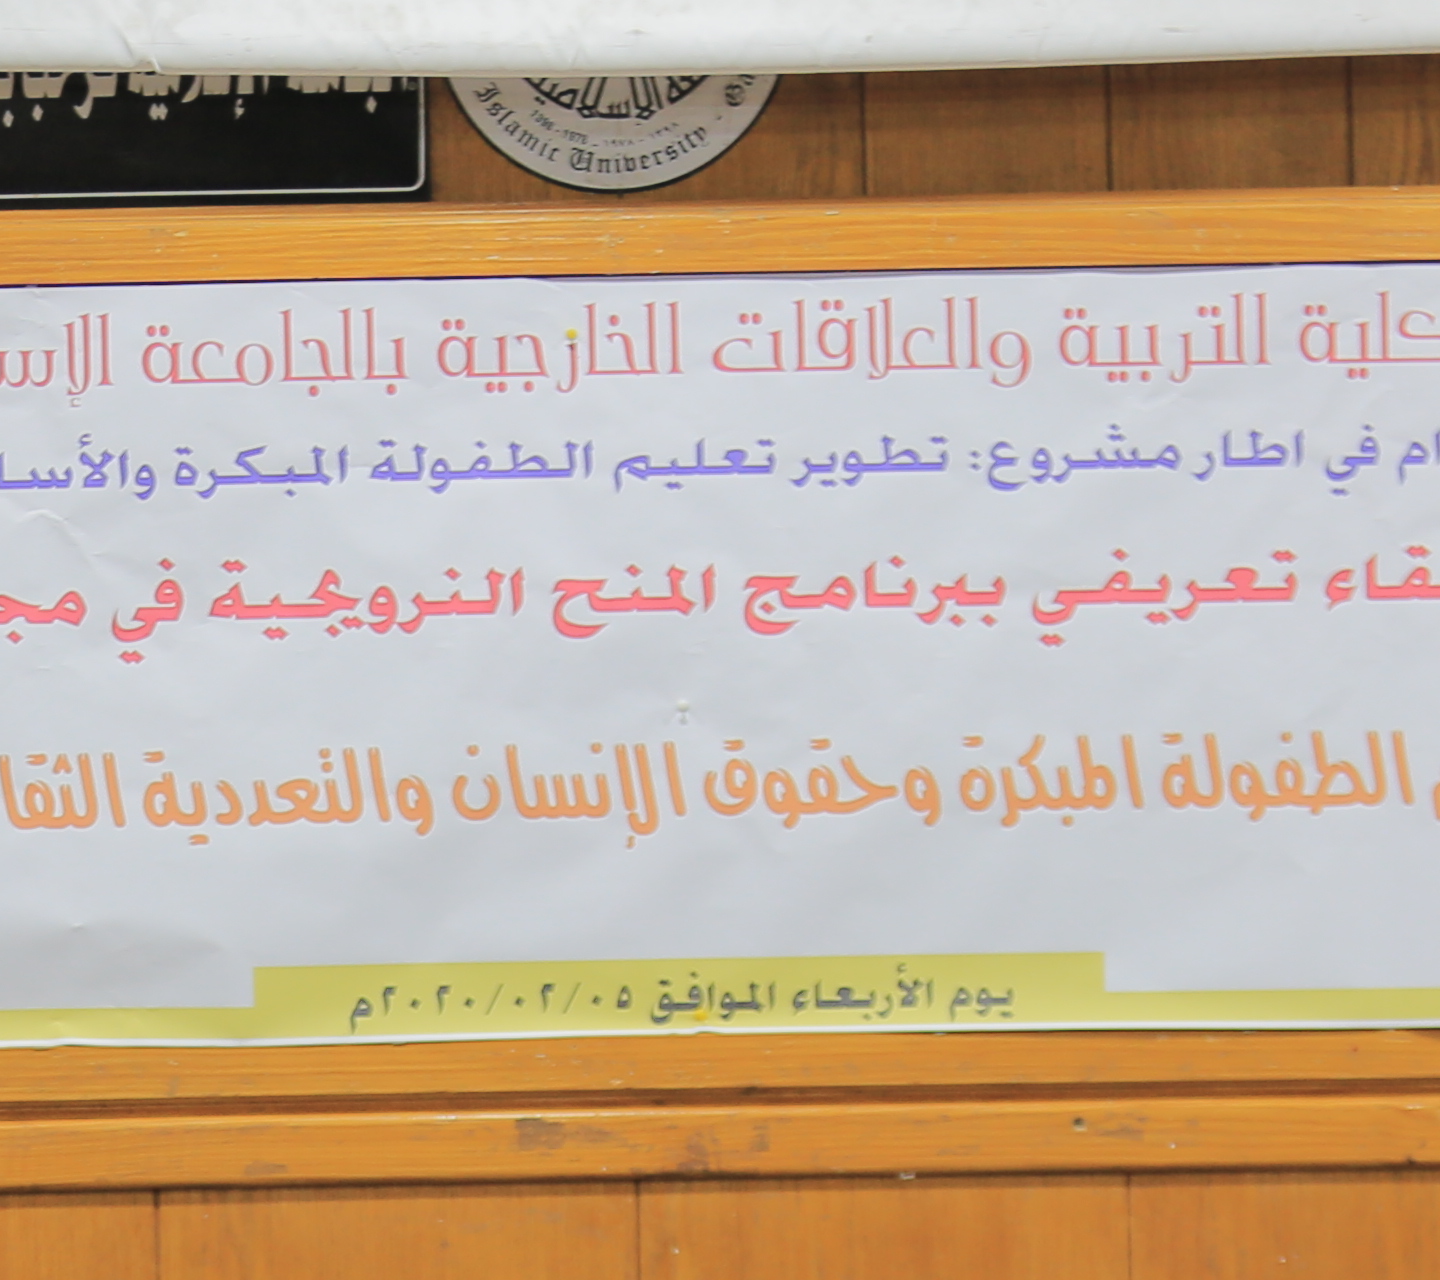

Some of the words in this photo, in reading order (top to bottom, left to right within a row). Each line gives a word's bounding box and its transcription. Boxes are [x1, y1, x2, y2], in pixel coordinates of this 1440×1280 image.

[474, 82, 560, 162] Islamic
[570, 126, 708, 174] University
[141, 307, 408, 398] بالجامعة
[436, 301, 683, 394] الخارجية
[711, 295, 1032, 388] والعلاقات
[1058, 292, 1269, 384] التربية
[174, 445, 348, 500] المبكرة
[369, 439, 593, 494] الطفولة
[613, 438, 776, 492] تعليم
[790, 435, 949, 488] تطوير
[970, 423, 1181, 492] مشروع:
[1192, 430, 1303, 482] اطار
[1324, 424, 1379, 496] في
[111, 557, 184, 664] في
[208, 559, 524, 640] النرويجية
[552, 563, 716, 640] المنح
[743, 554, 1007, 636] ببرنامج
[1031, 547, 1299, 647] تعريفي
[143, 747, 434, 845] والتعددية
[451, 741, 686, 848] الإنسان
[703, 738, 942, 829] وحقوق
[959, 734, 1144, 827] المبكرة
[1161, 730, 1415, 821] الطفولة
[650, 979, 775, 1025] الموافق
[791, 963, 933, 1019] الأربعاء
[949, 986, 1013, 1018] يوم
